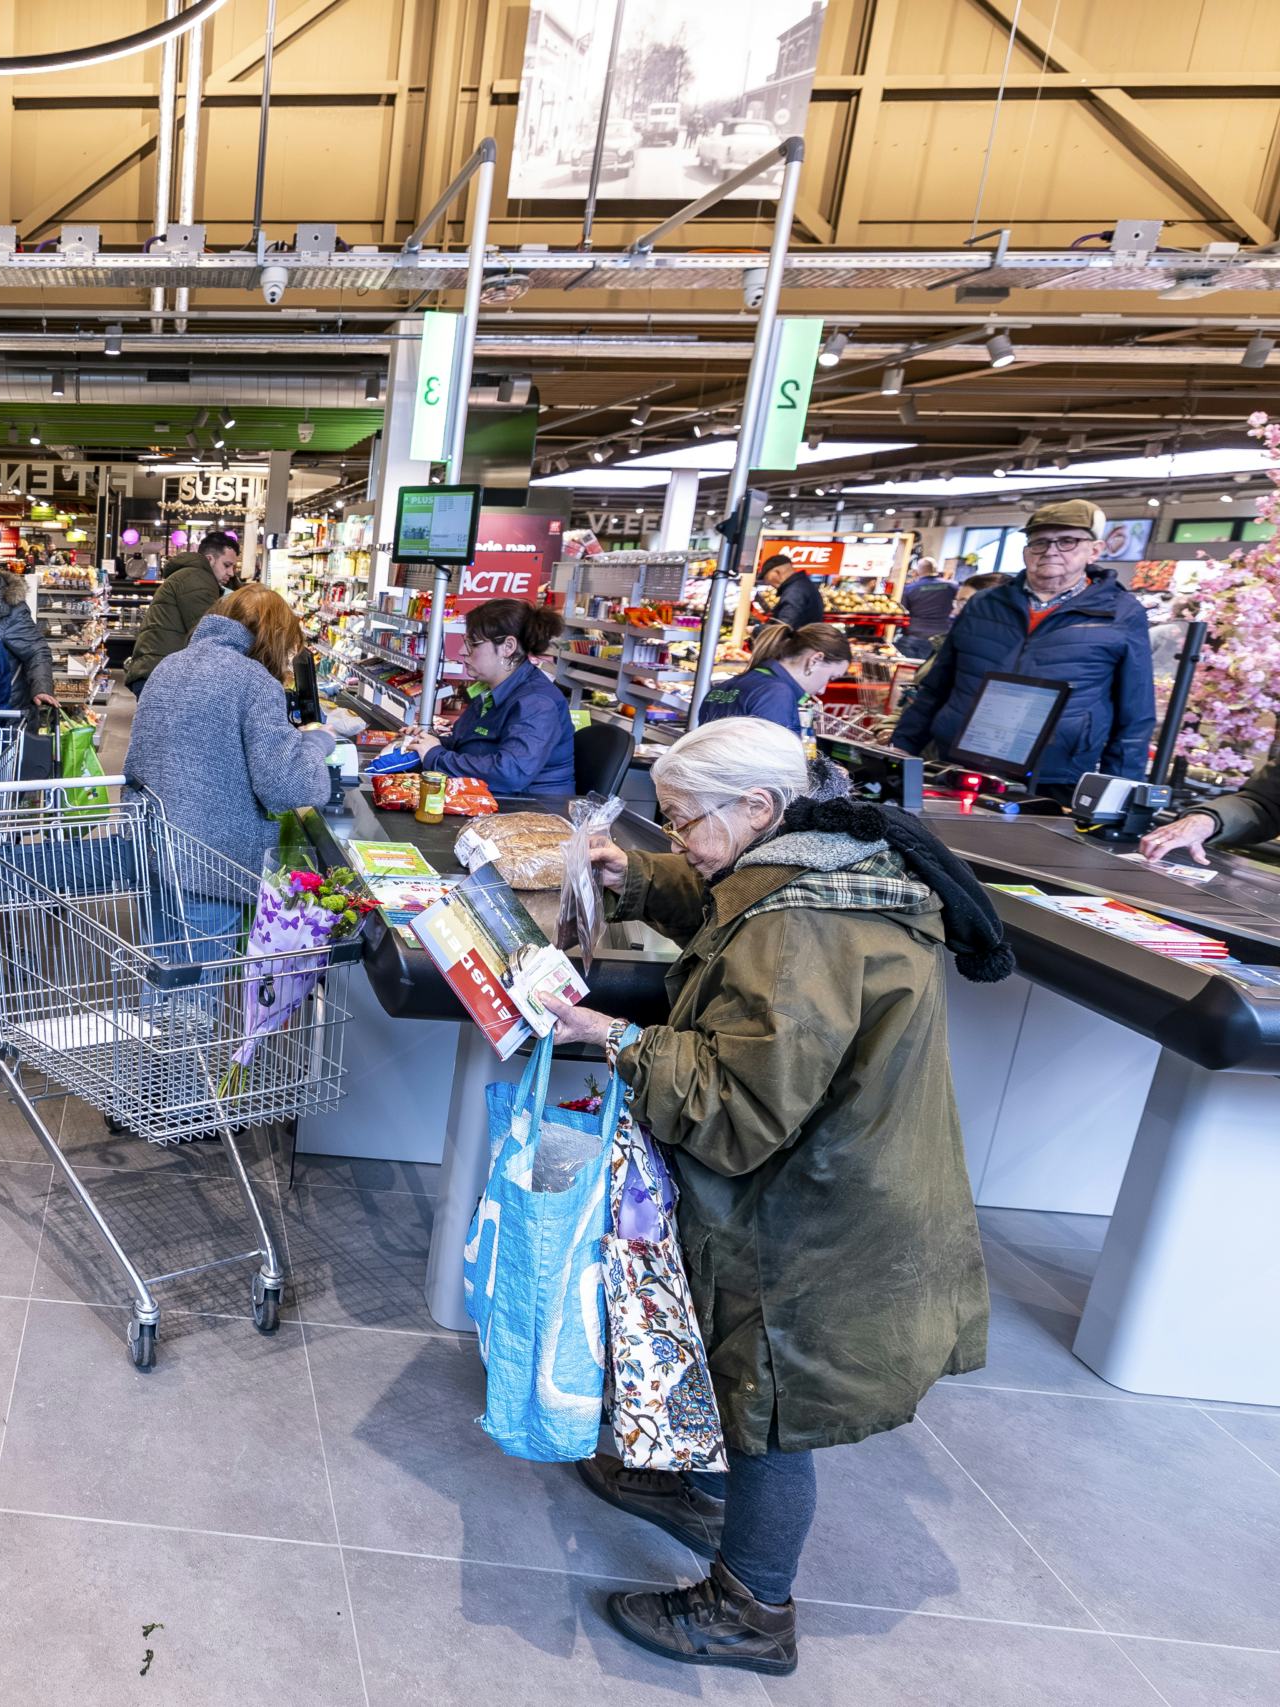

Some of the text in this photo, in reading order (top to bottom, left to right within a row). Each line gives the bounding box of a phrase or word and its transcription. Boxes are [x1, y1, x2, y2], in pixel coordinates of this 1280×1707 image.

[181, 475, 260, 502] SUSHI
[410, 495, 434, 504] PLUS
[587, 510, 661, 535] VLEE
[459, 571, 532, 596] ACTIE
[435, 918, 512, 1020] EIJSDEN
